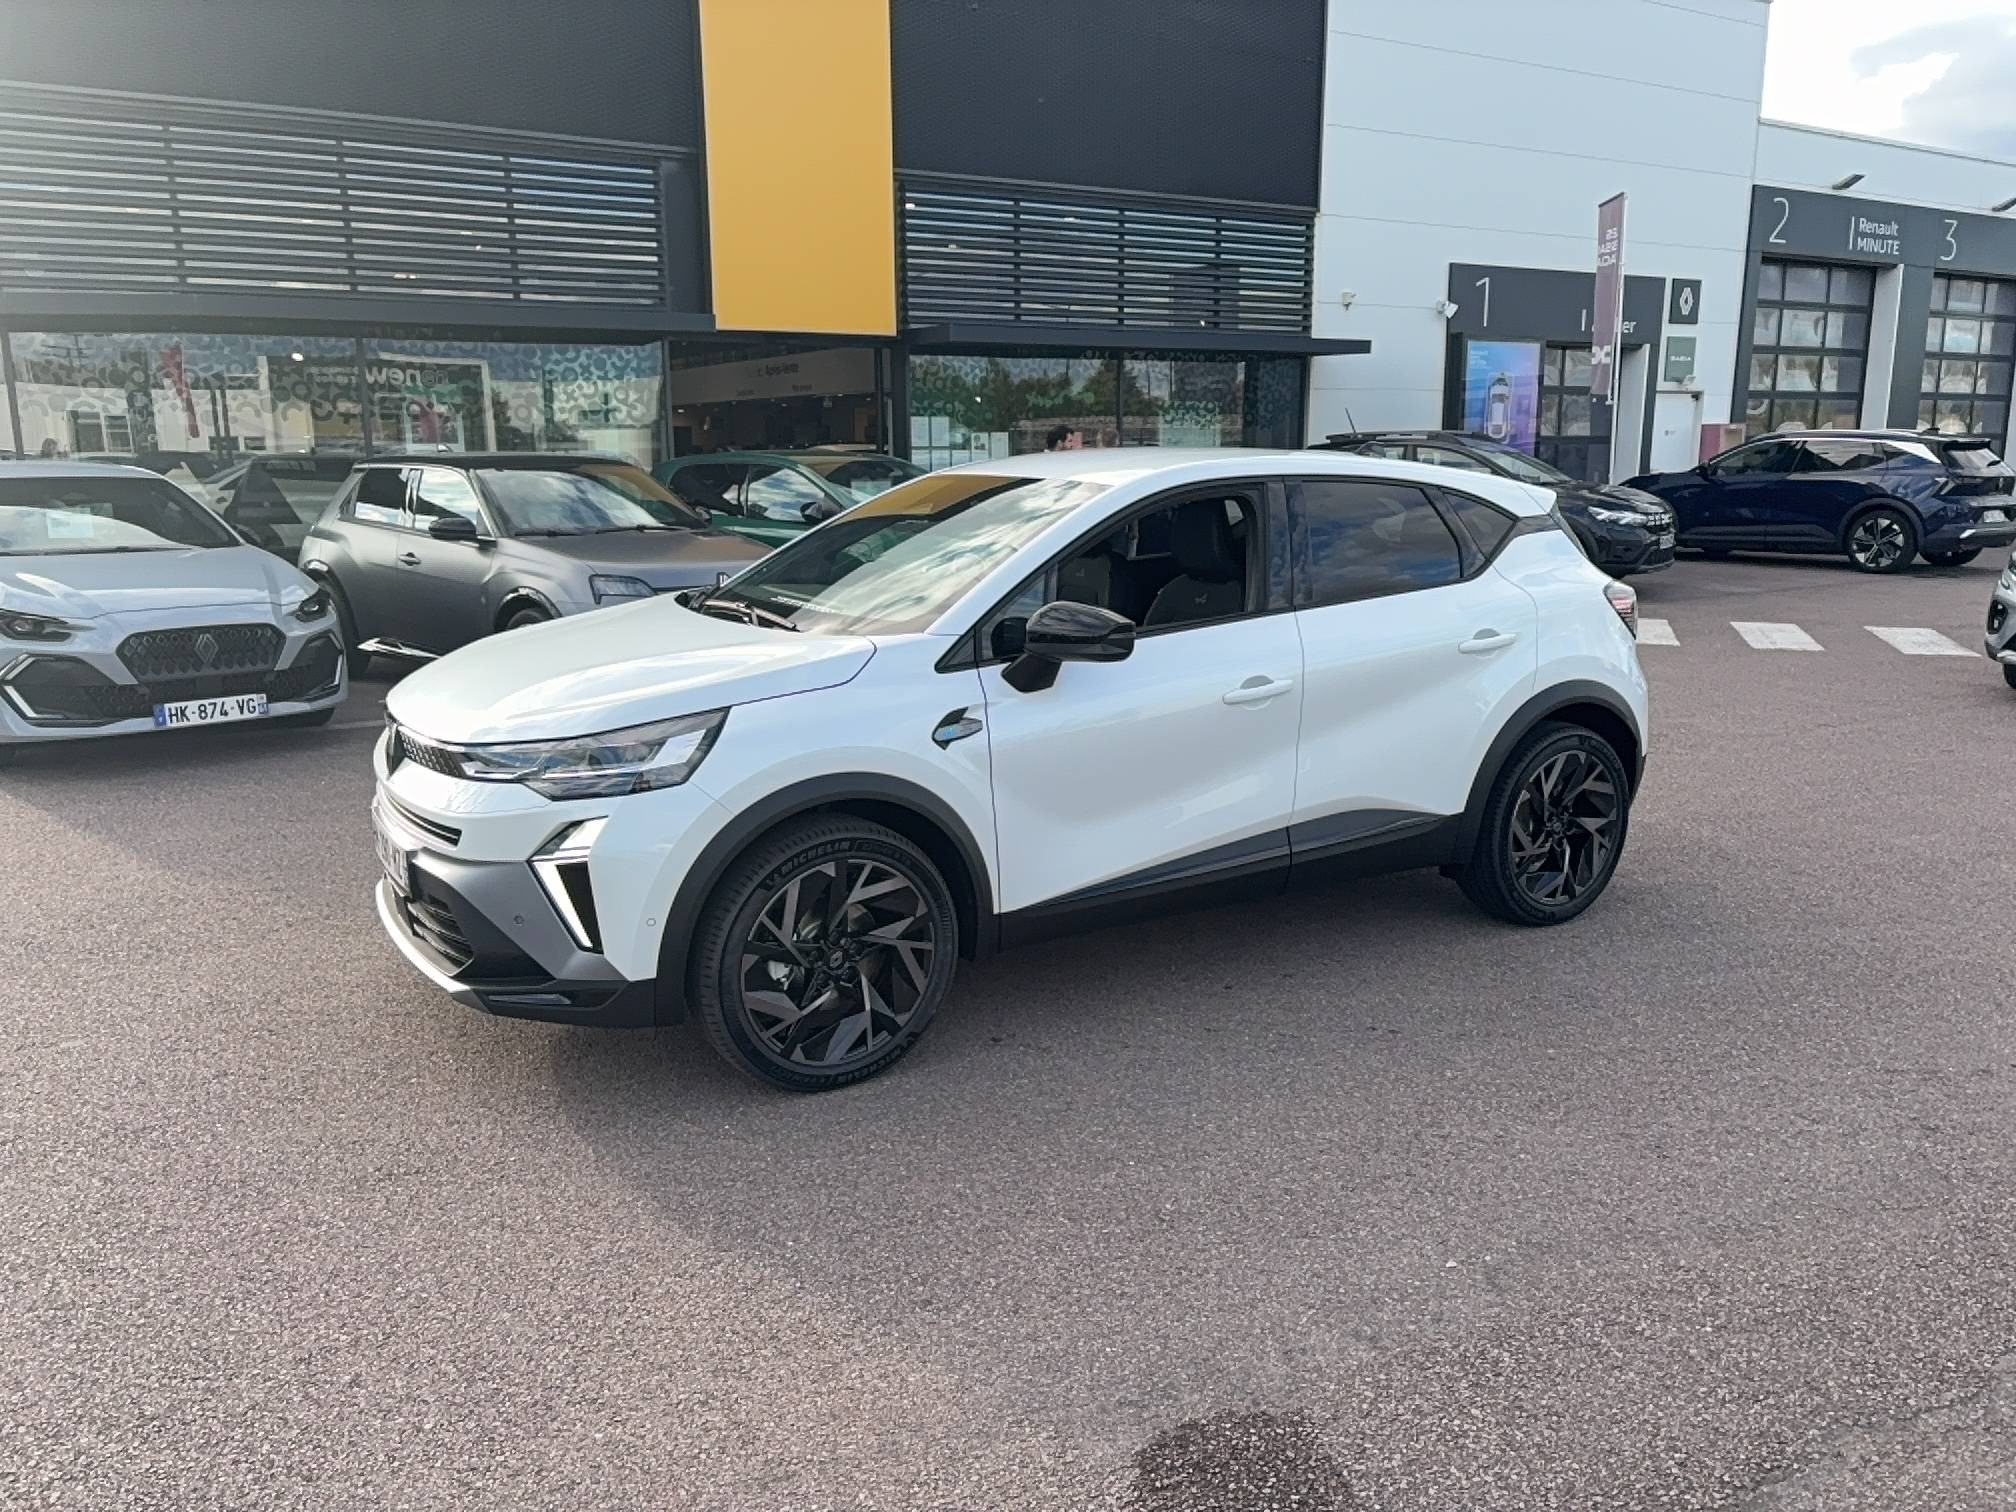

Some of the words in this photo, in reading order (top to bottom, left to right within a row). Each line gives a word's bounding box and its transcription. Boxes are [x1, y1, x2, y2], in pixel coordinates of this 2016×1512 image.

[1769, 197, 1790, 244] 2
[1858, 217, 1899, 236] Renault
[1857, 237, 1900, 255] MINUTE
[1940, 219, 1958, 261] 3
[1475, 277, 1490, 327] 1
[168, 698, 257, 724] HK-874-VG
